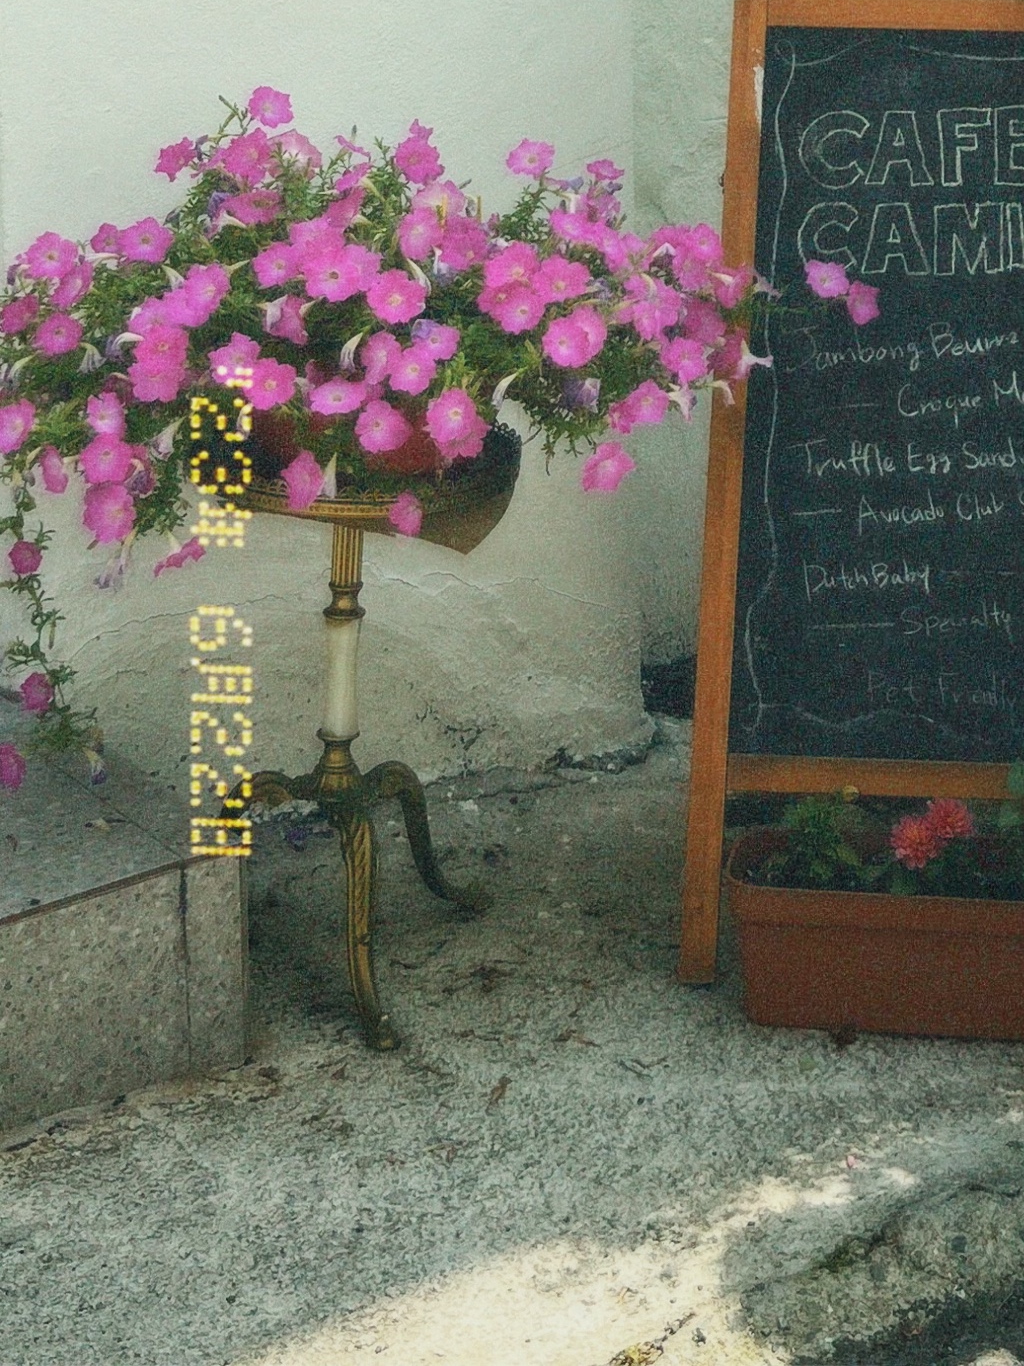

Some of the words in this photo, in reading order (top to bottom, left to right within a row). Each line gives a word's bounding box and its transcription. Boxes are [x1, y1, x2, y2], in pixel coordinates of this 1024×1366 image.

[898, 384, 982, 428] Croque
[788, 438, 894, 476] Truffle
[907, 442, 951, 474] Egg
[858, 488, 945, 535] Avocado
[956, 491, 1004, 521] Club
